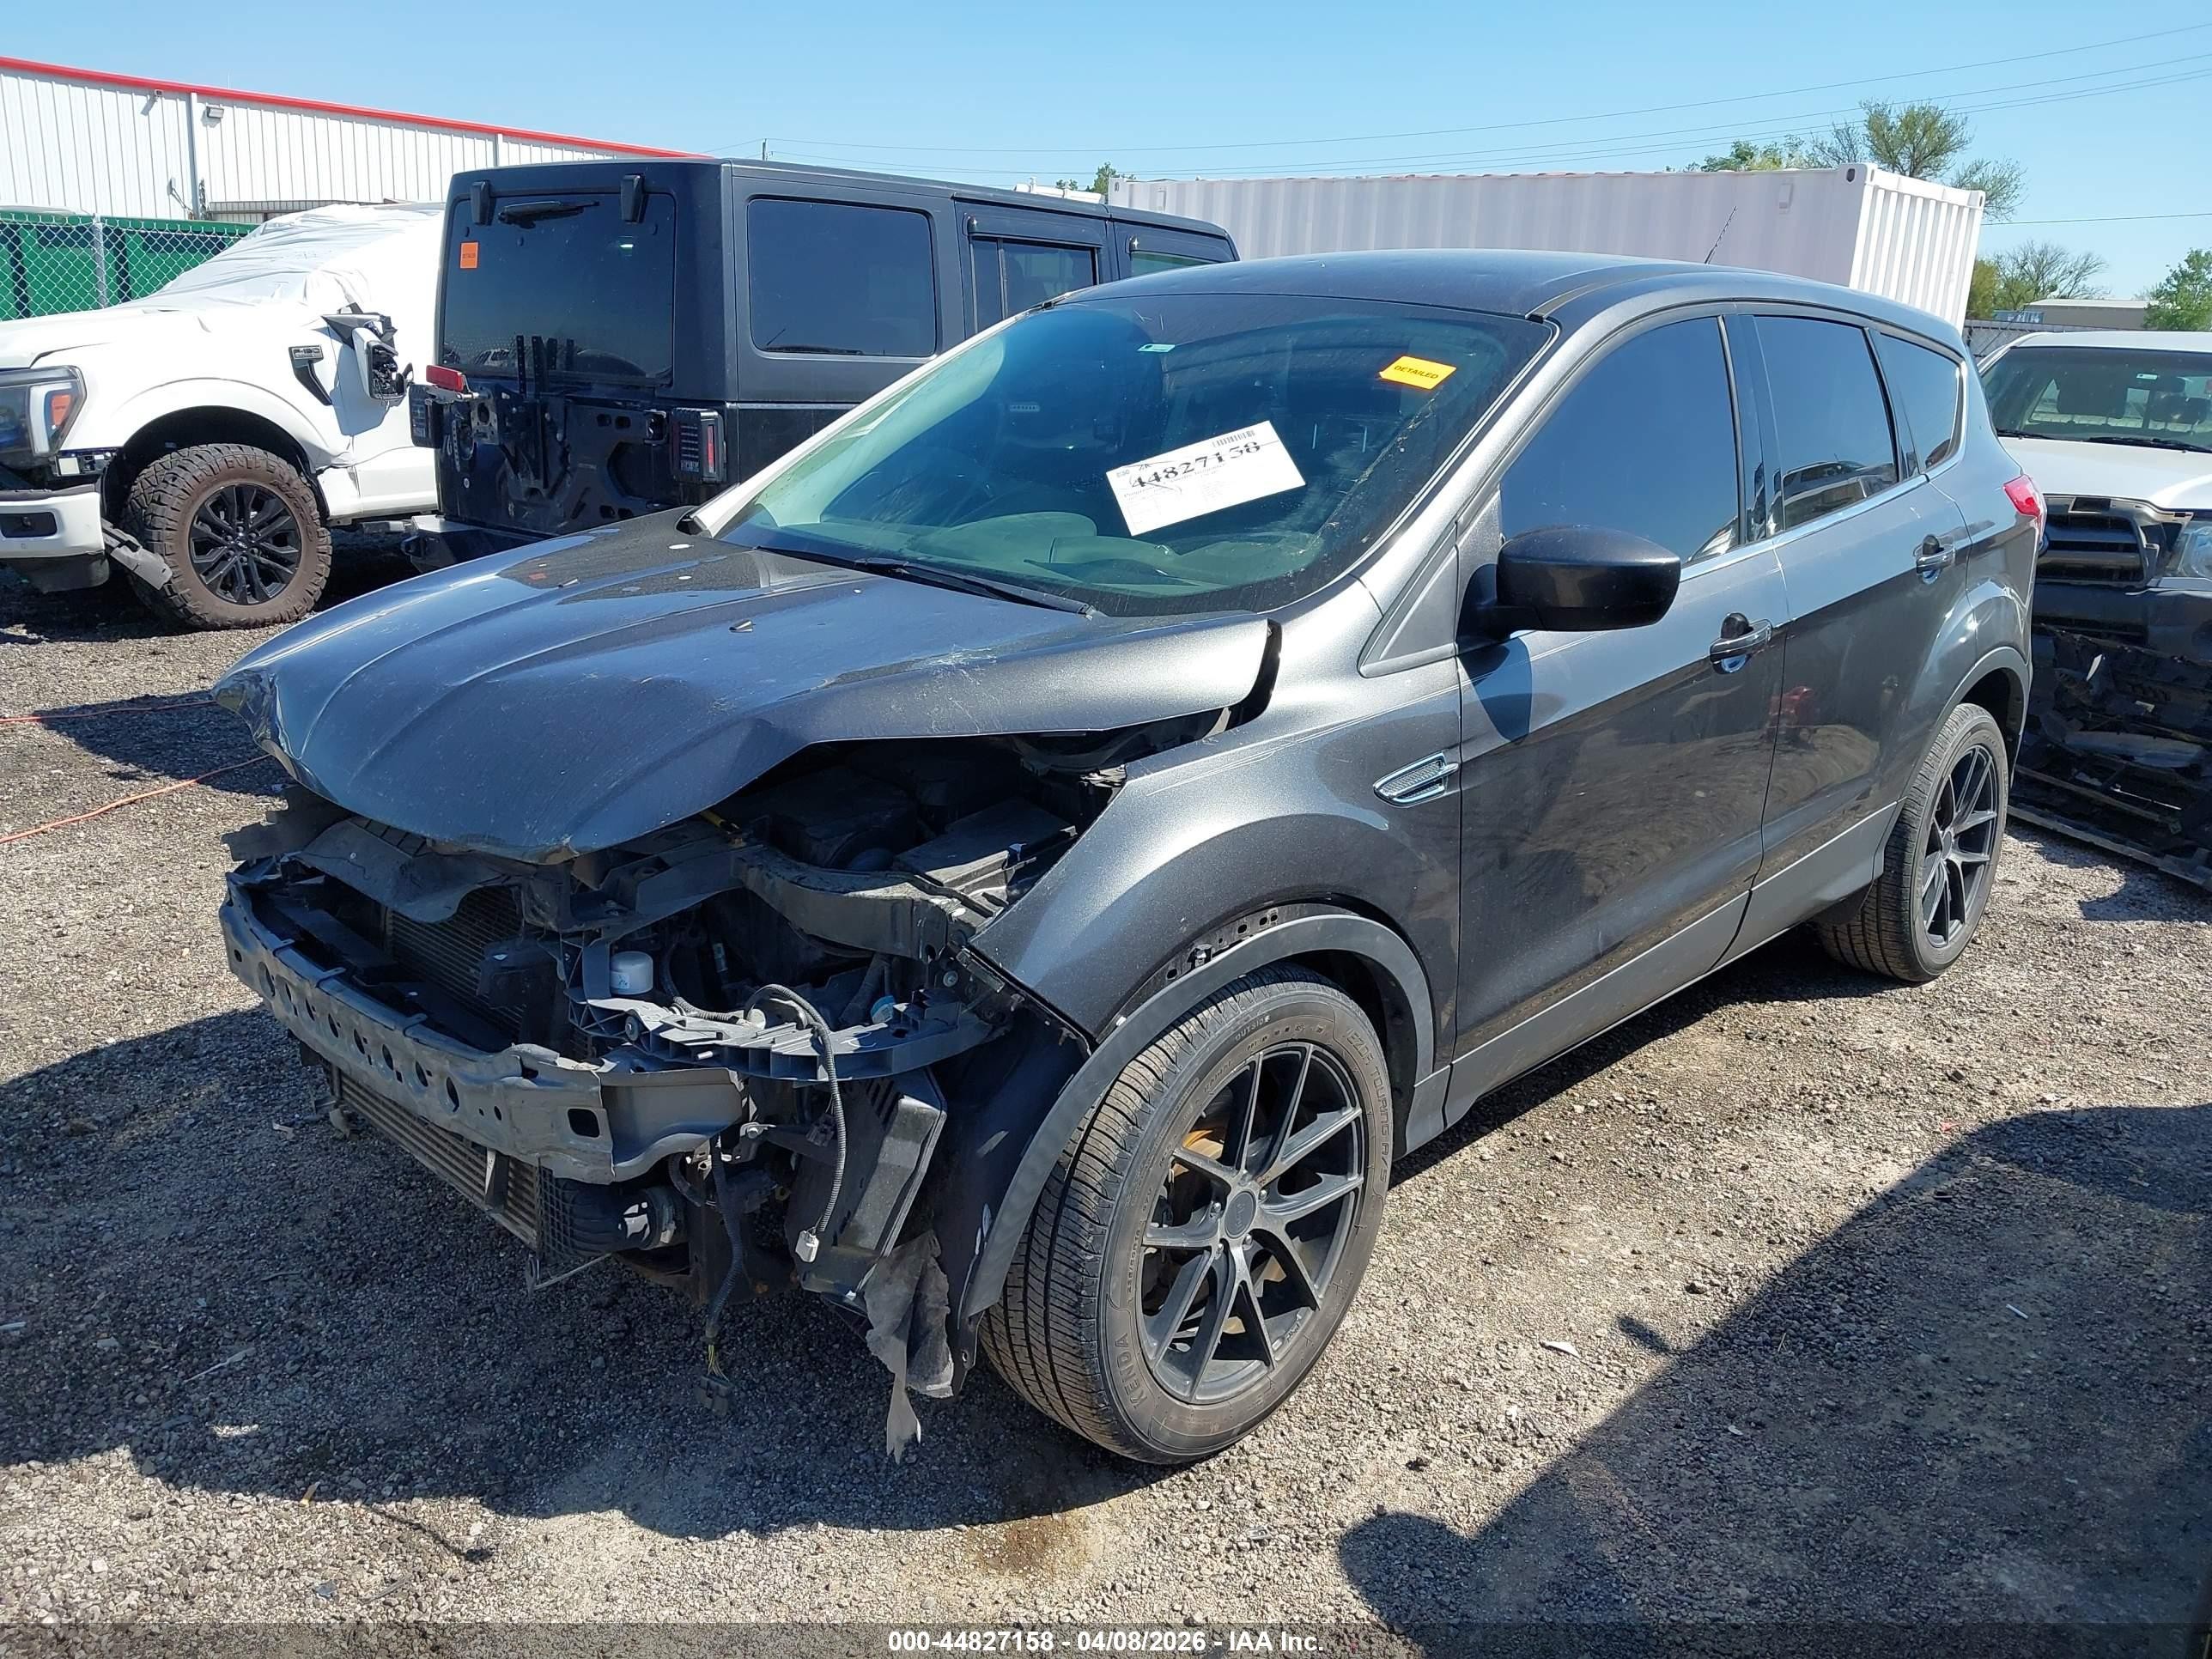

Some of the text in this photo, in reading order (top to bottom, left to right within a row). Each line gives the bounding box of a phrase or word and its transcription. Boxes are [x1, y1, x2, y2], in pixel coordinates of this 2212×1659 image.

[1394, 365, 1439, 380] DETAILED
[1370, 1066, 1389, 1135] TOURING
[1380, 1142, 1389, 1182] A/S
[1115, 1333, 1148, 1409] KENDA
